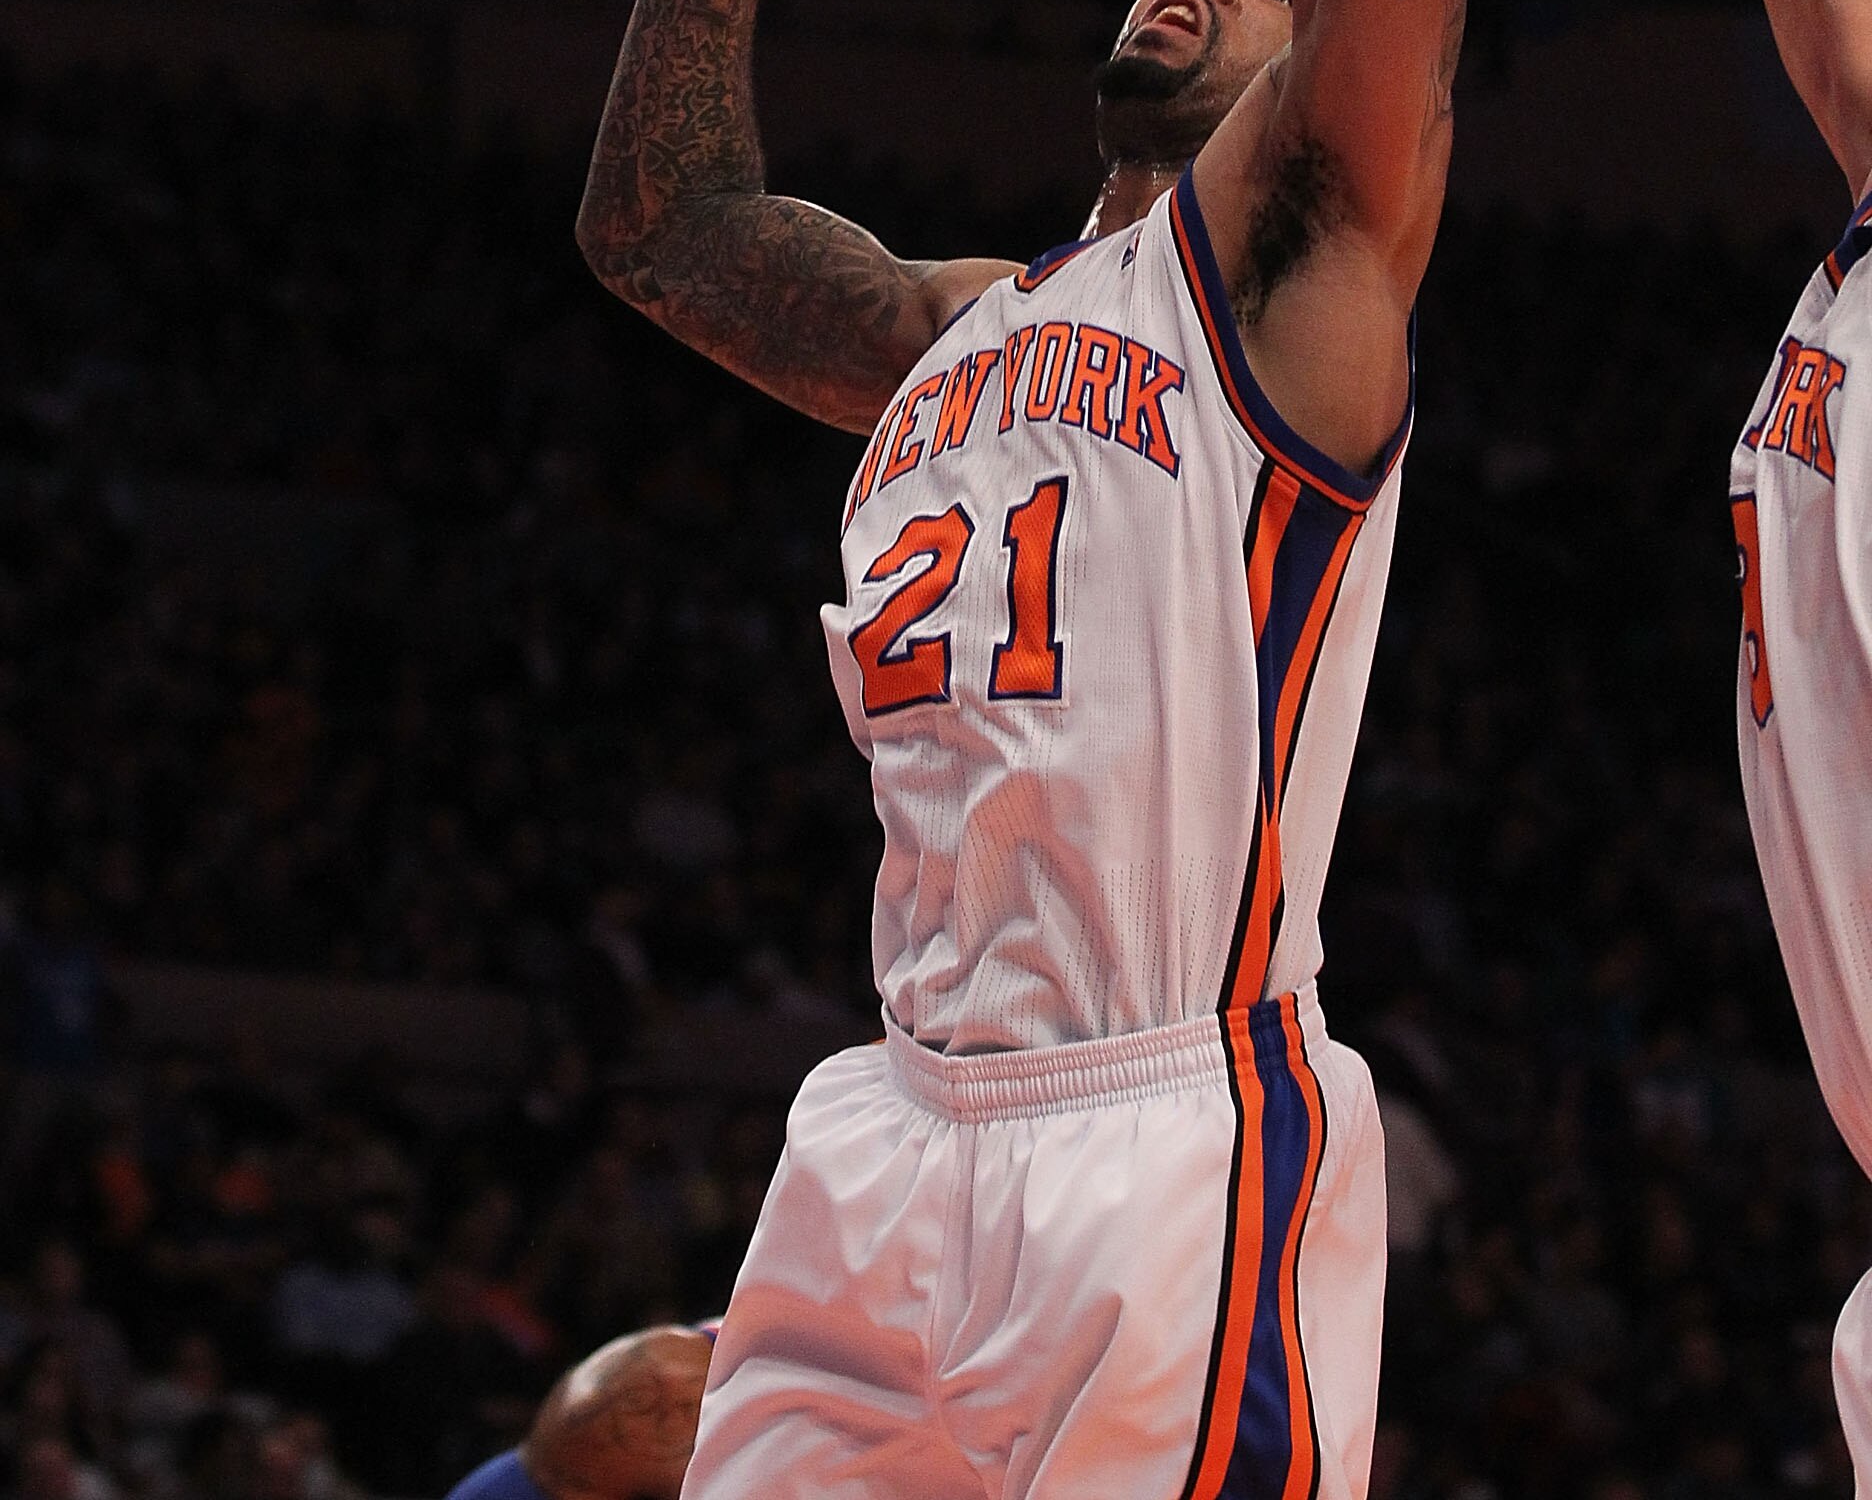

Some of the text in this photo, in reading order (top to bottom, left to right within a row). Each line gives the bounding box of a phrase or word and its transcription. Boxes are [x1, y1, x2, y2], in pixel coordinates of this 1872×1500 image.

[843, 321, 1185, 528] NEW YORK
[847, 475, 1070, 718] 21
